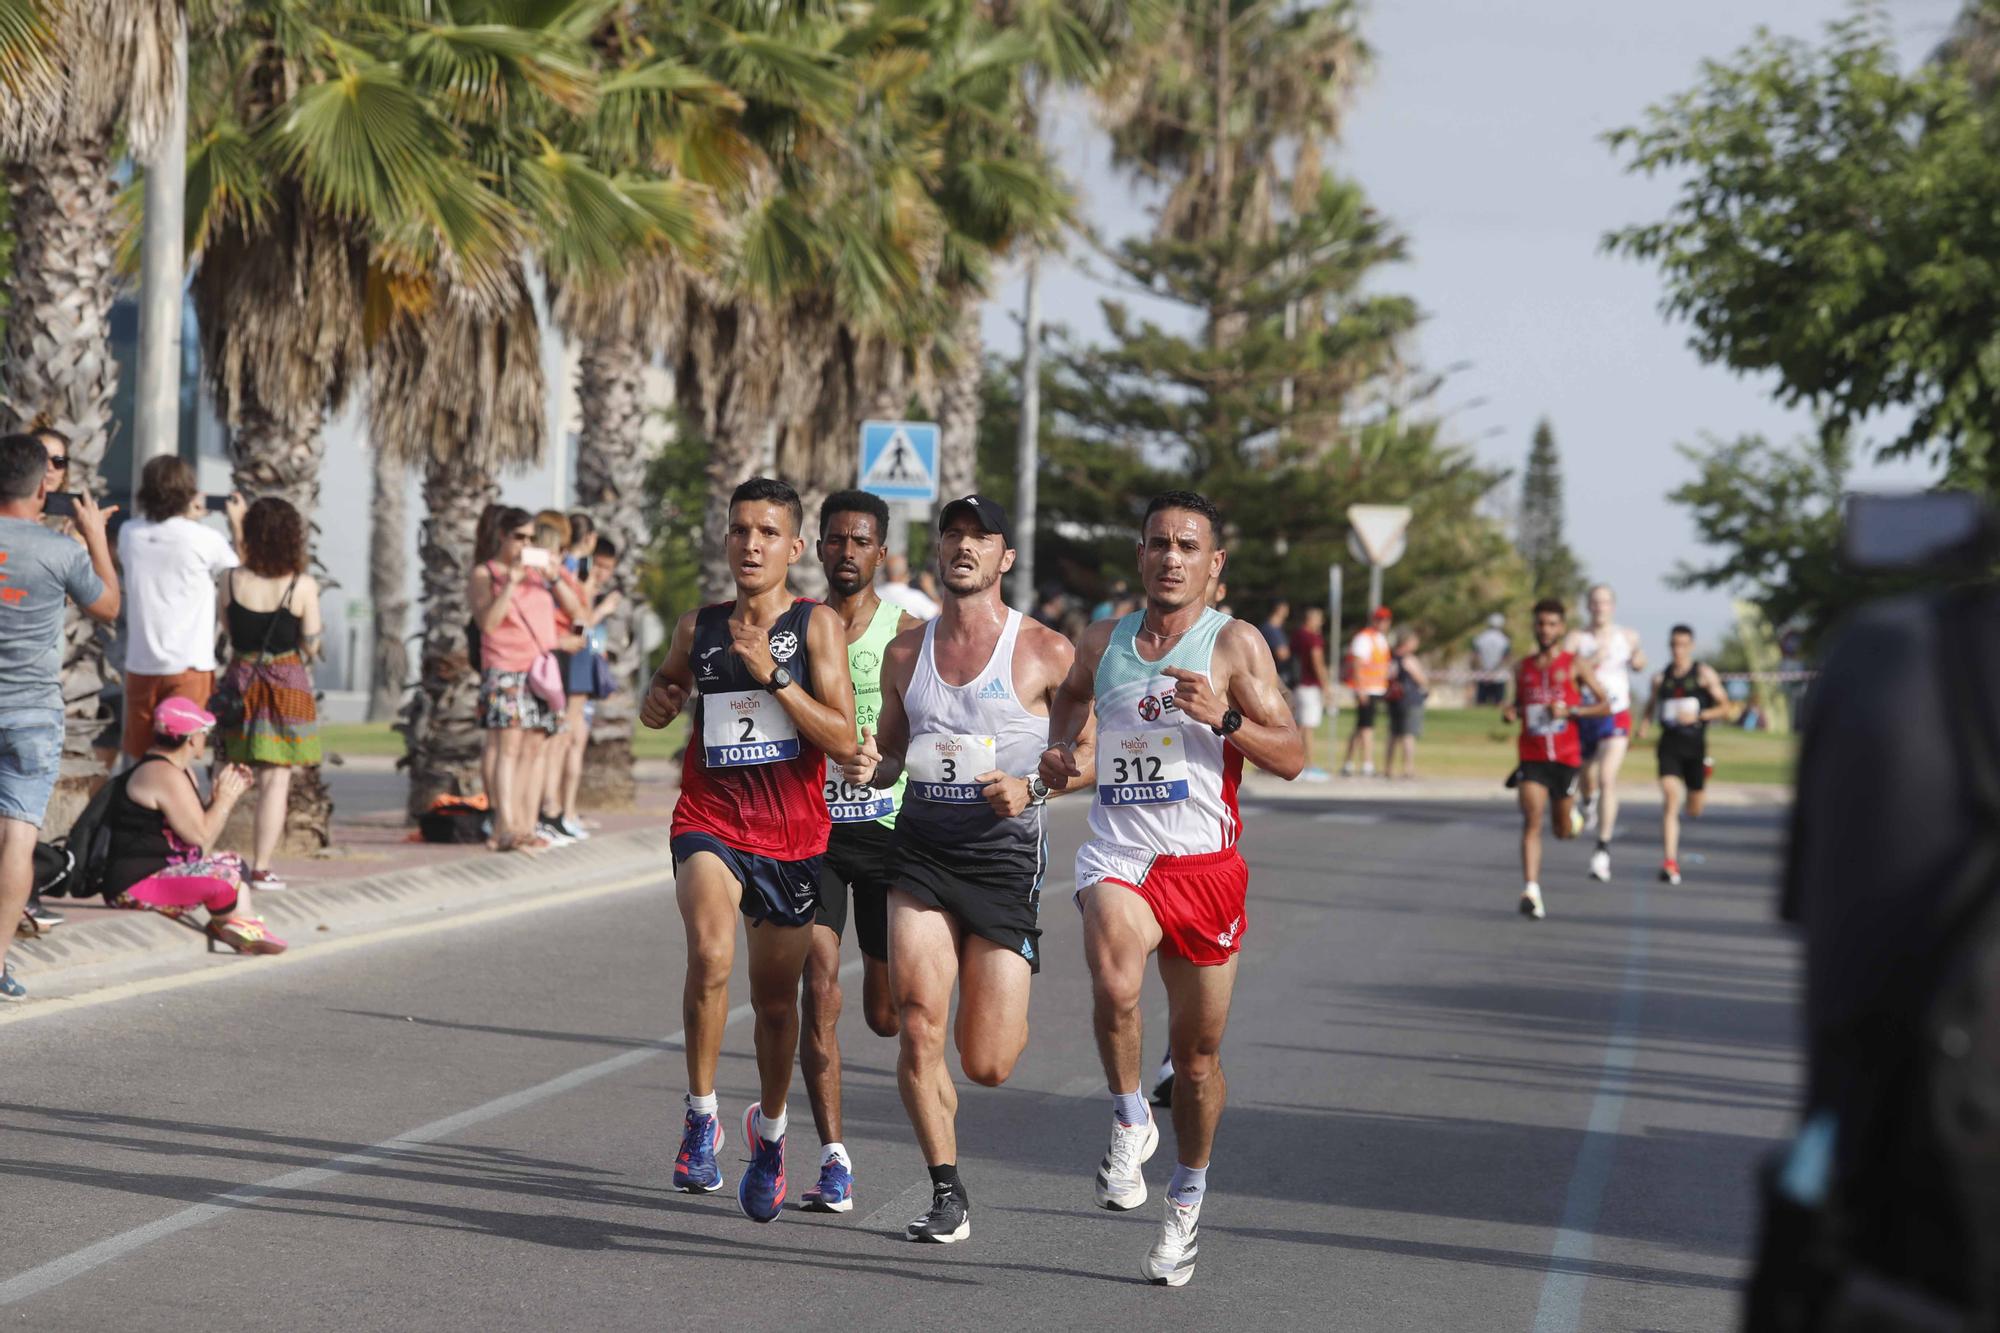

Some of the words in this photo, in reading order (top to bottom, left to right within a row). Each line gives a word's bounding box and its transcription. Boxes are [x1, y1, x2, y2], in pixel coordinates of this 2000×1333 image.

[978, 690, 1009, 699] adidas
[738, 717, 756, 742] 2
[941, 758, 956, 782] 3
[1113, 756, 1165, 783] 312
